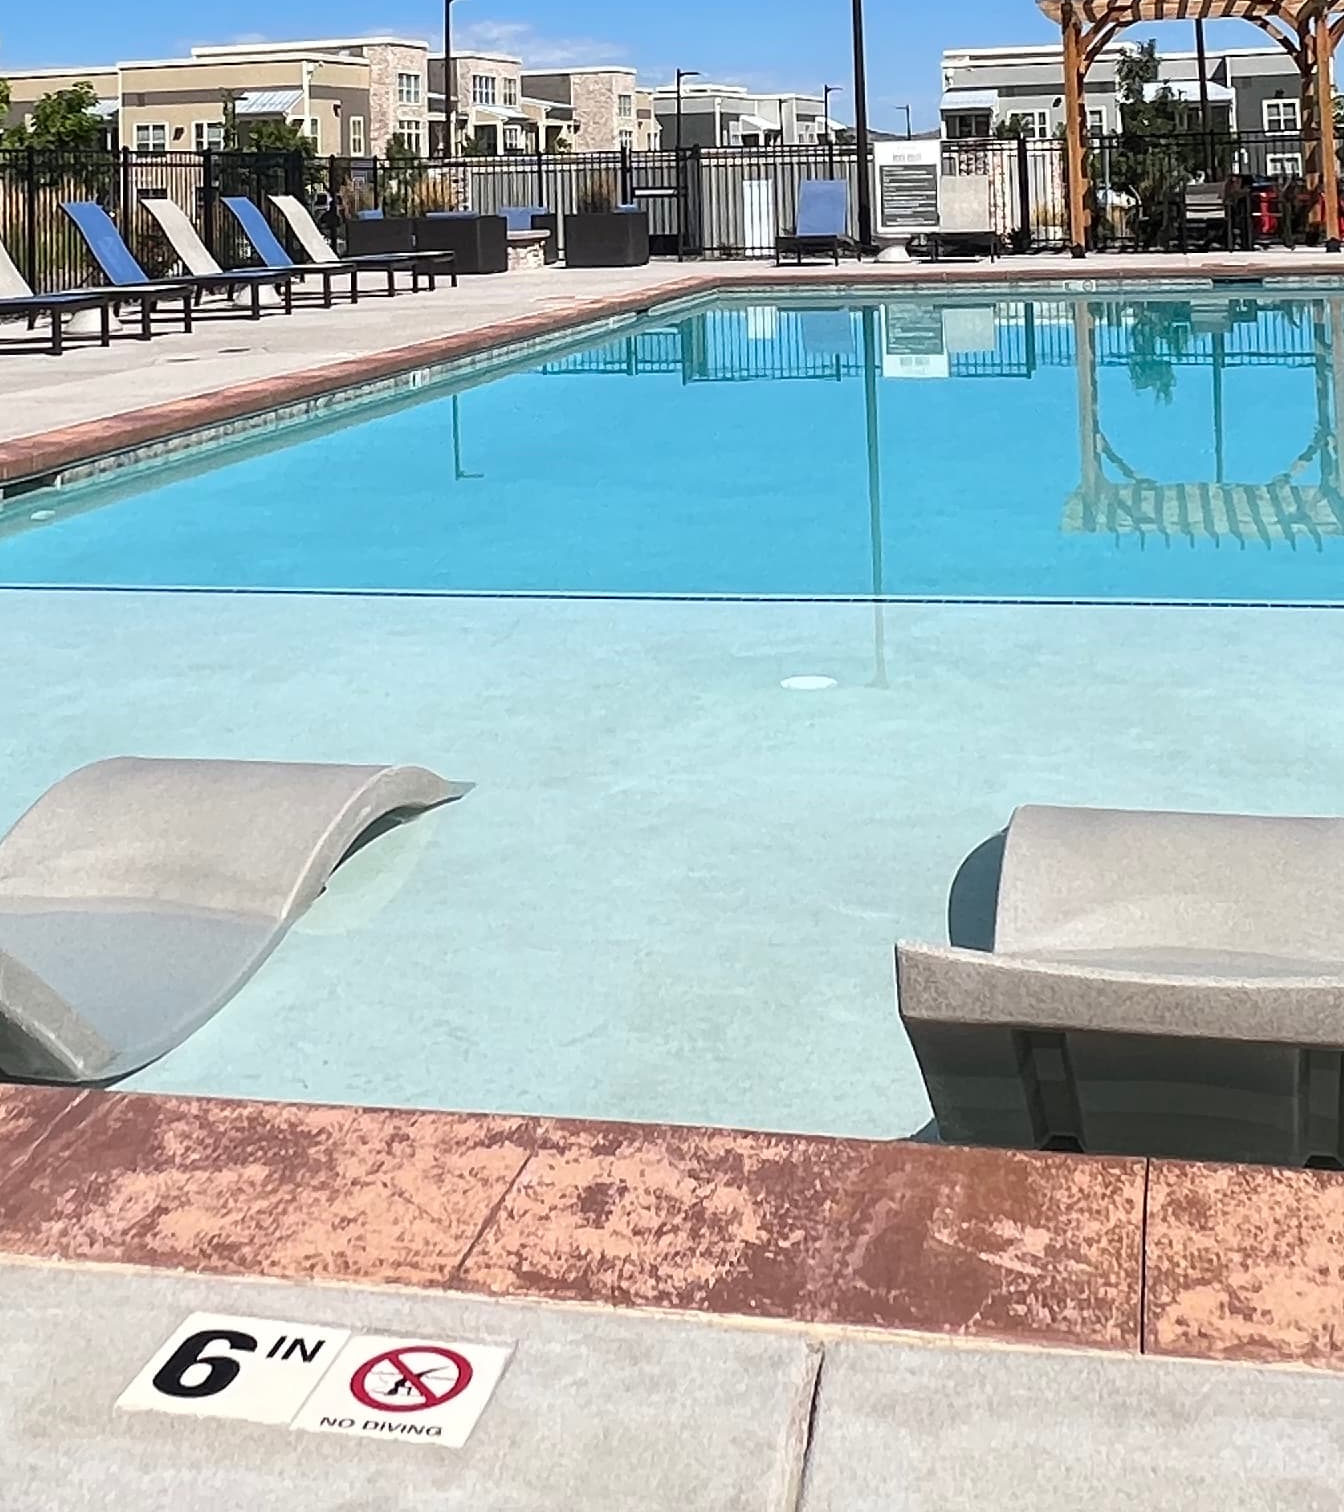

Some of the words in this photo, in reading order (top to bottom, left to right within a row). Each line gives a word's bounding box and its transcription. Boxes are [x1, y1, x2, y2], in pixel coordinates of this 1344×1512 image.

[153, 1329, 257, 1399] 6
[267, 1335, 326, 1364] IN
[320, 1417, 355, 1428] NO
[363, 1420, 442, 1437] DIVING
